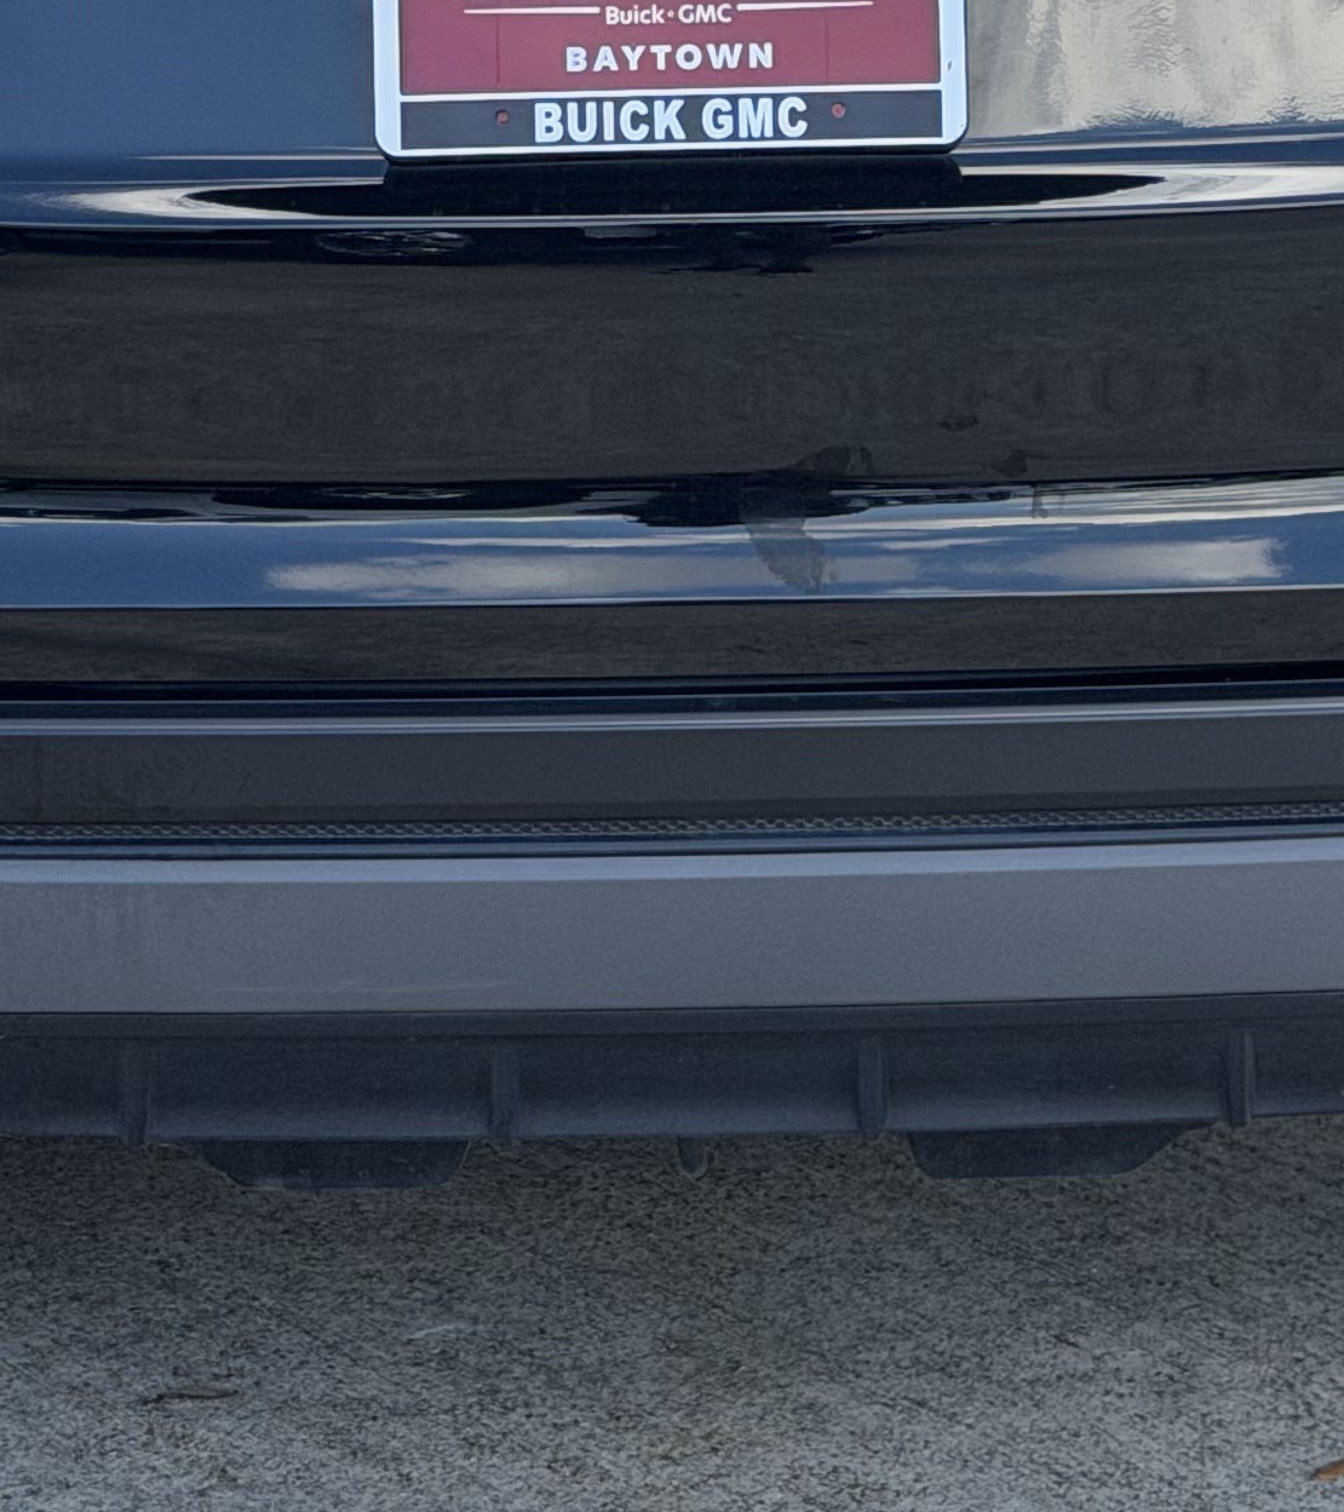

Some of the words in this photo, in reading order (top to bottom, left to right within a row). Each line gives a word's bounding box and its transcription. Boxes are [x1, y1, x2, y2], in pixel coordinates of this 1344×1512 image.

[678, 3, 733, 24] GMC
[565, 41, 775, 73] BAYTOWN
[534, 100, 687, 144] BUICK
[701, 96, 809, 140] GMC
